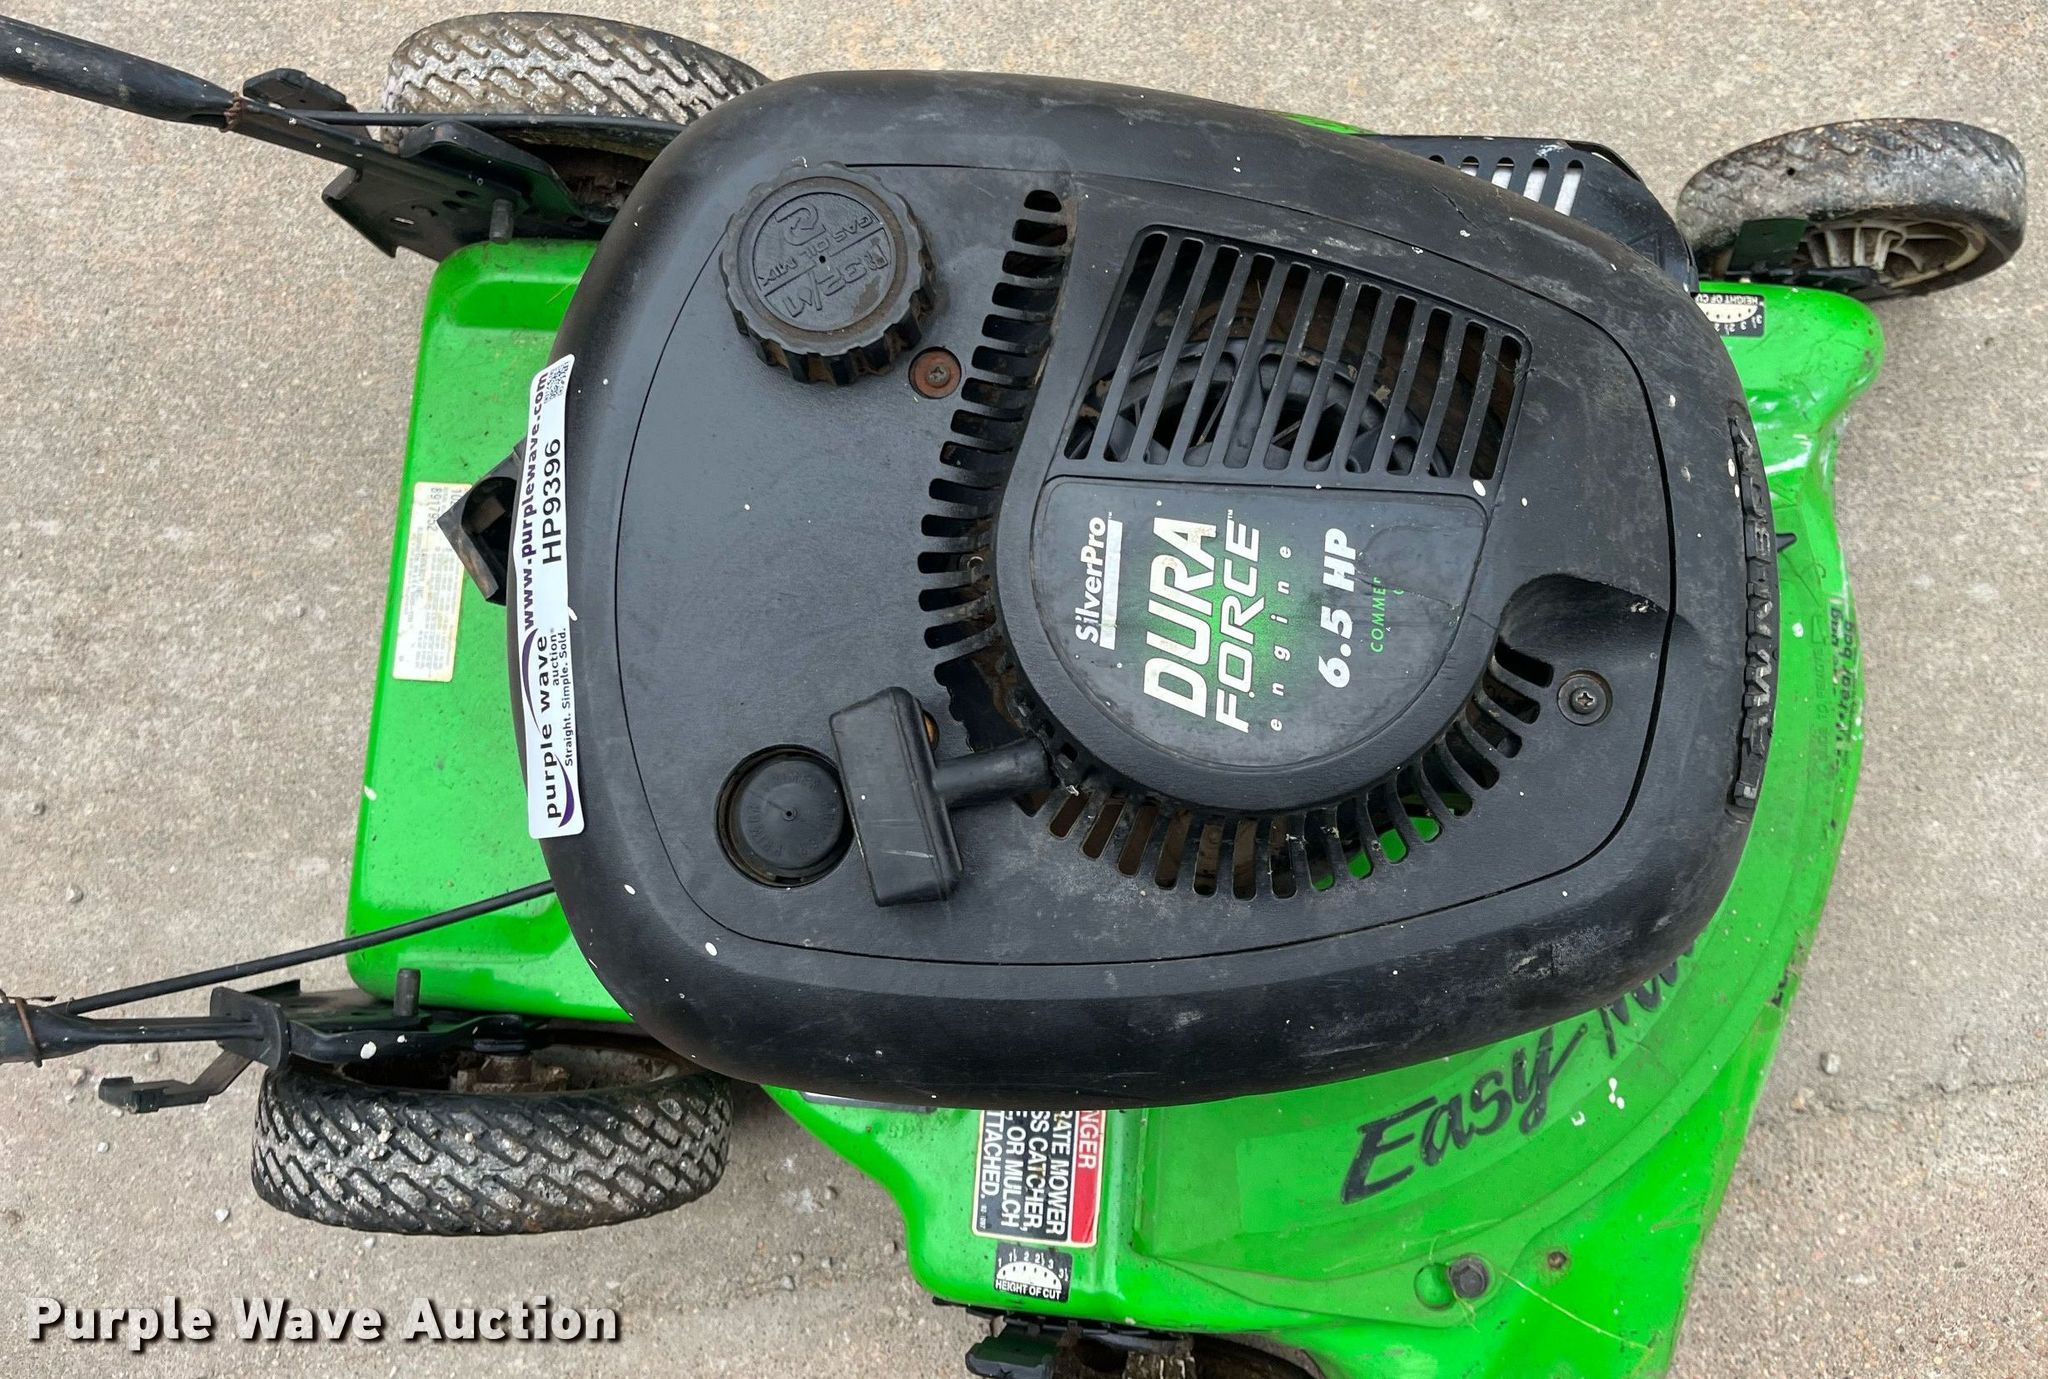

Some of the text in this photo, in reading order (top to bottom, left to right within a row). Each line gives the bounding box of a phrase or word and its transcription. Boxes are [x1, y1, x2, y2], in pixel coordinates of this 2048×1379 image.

[756, 256, 799, 287] MIX
[1696, 294, 1758, 304] HEIGHT OF CU
[522, 373, 548, 630] www.purplewave.com
[542, 439, 562, 565] HP9396
[1074, 516, 1106, 644] SilverPro
[1144, 516, 1218, 718] DURA
[1214, 517, 1266, 734] FORCE
[1318, 528, 1356, 688] 6.5 HP
[550, 633, 560, 687] auction
[558, 627, 574, 767] Straight. Simple. Sold.
[537, 635, 562, 819] purple wave
[980, 1110, 1005, 1199] TTACHED.
[1005, 1126, 1026, 1155] OR
[1077, 1110, 1100, 1169] NGER
[1340, 1022, 1589, 1206] Easy
[1000, 1158, 1023, 1228] MULCH
[1020, 1136, 1047, 1232] CATCHER,
[1046, 1110, 1072, 1235] RATE MOWER
[996, 1280, 1062, 1300] HEIGHT OF CUT
[1024, 1250, 1030, 1261] 2
[1048, 1258, 1054, 1270] 3
